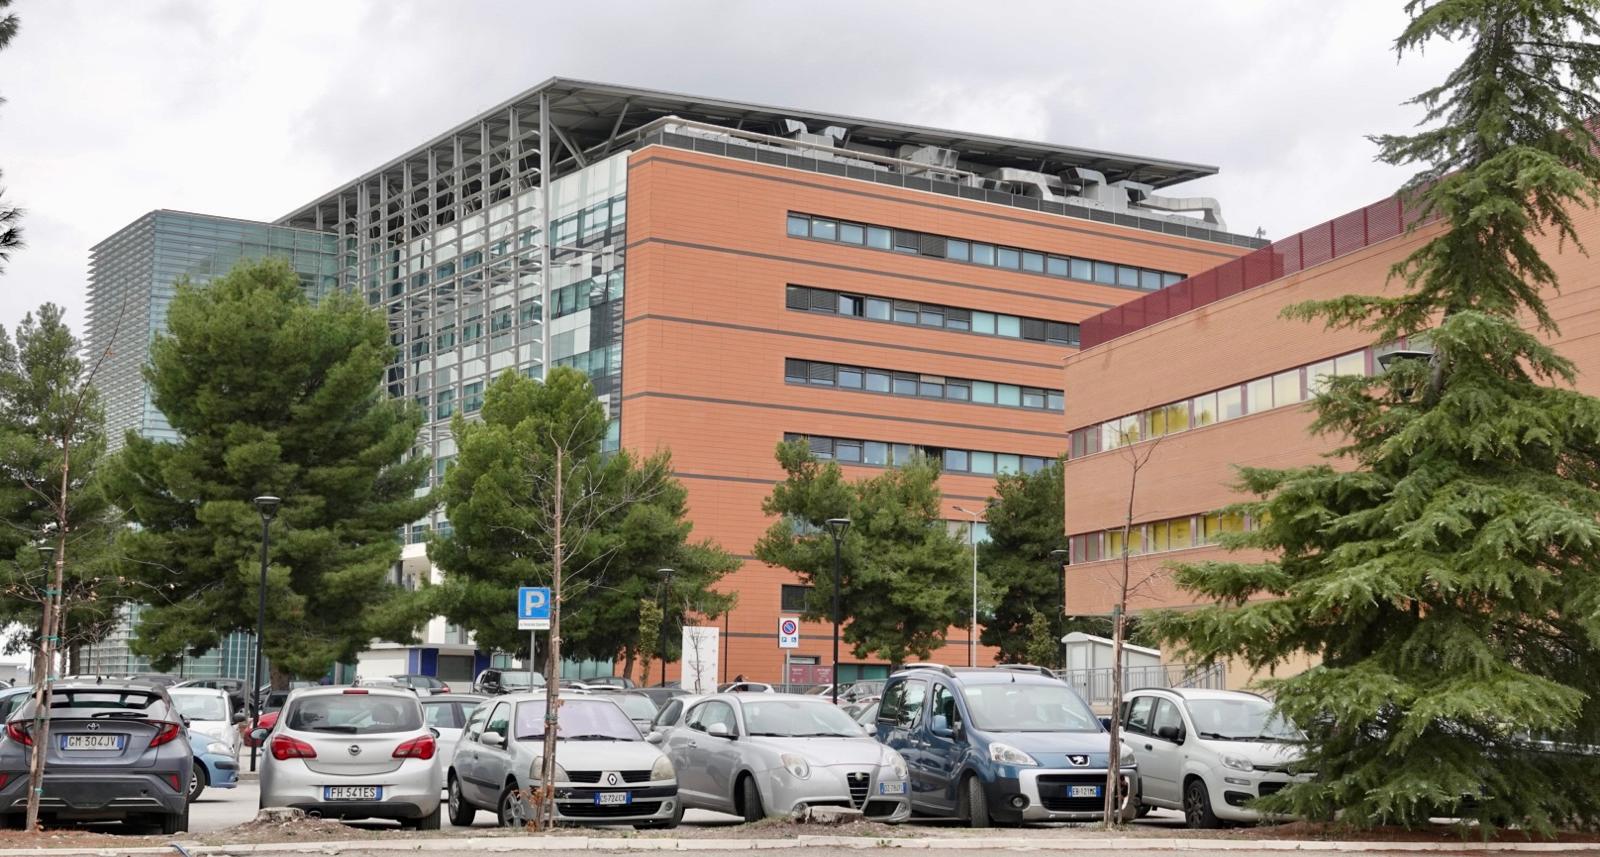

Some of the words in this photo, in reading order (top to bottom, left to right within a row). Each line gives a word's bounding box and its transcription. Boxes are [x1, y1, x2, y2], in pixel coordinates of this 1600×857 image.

[525, 591, 545, 616] P
[85, 736, 116, 747] 304JV
[331, 787, 343, 798] FH
[346, 787, 375, 798] 541ES
